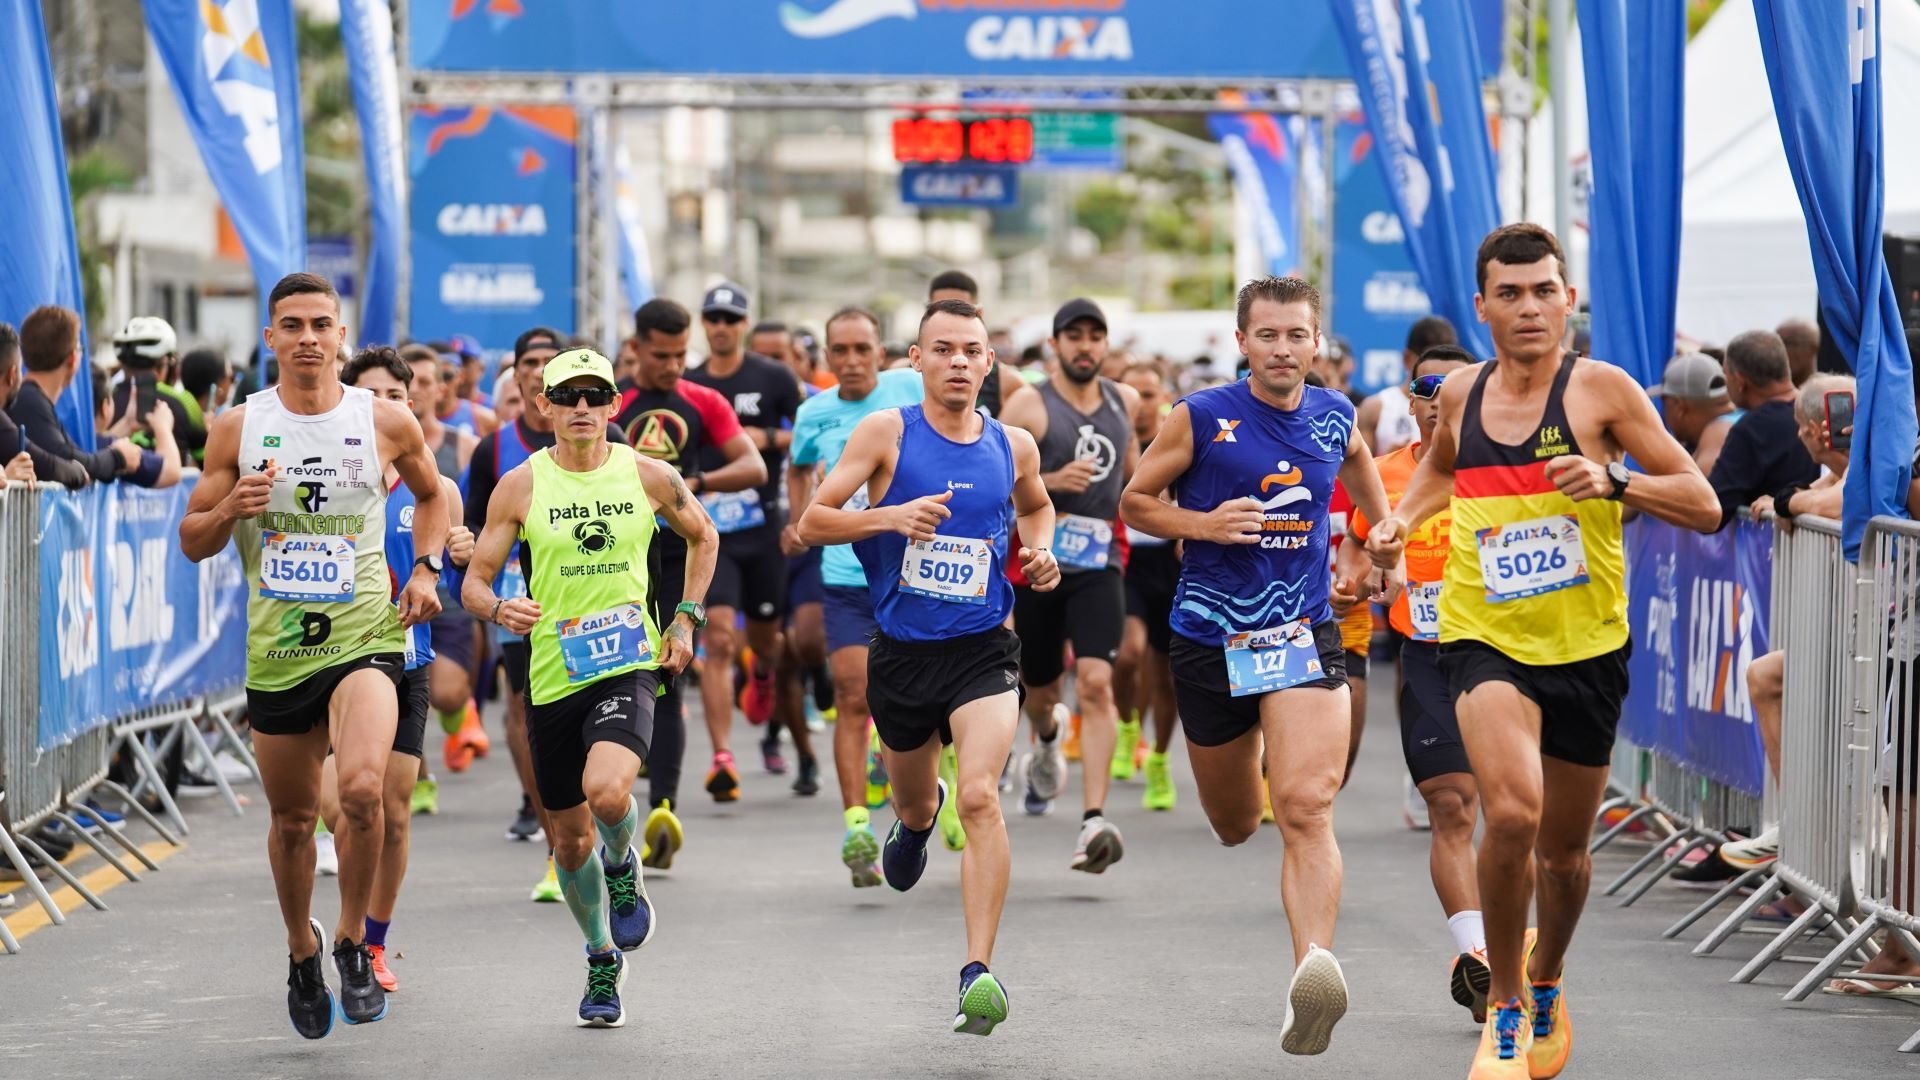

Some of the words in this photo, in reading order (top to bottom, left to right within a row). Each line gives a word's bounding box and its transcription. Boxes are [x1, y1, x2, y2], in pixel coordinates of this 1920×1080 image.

[966, 16, 1133, 60] CAIXA
[912, 174, 1004, 199] CAIXA
[437, 203, 547, 236] CAIXA
[286, 467, 337, 476] revom
[549, 502, 590, 524] pata
[596, 501, 634, 517] leve
[1264, 513, 1289, 521] CUITO
[1289, 513, 1300, 521] DE
[1261, 520, 1314, 531] ORRIDAS
[1260, 535, 1308, 549] CAIXA
[1504, 526, 1552, 544] CAIXA
[285, 541, 328, 551] CAIXA
[932, 541, 972, 554] CAIXA
[560, 566, 585, 577] EQUIPE
[586, 565, 595, 575] DE
[597, 561, 629, 574] ATLETISMO
[1496, 546, 1567, 579] 5026
[270, 558, 338, 582] 15610
[919, 558, 974, 584] 5019
[341, 581, 352, 593] C
[977, 585, 985, 595] A
[1424, 587, 1442, 597] CAI
[582, 613, 621, 631] CAIXA
[1249, 630, 1288, 645] CAIXA
[266, 646, 341, 659] RUNNING
[586, 631, 621, 660] 117
[640, 643, 649, 654] A
[406, 652, 414, 662] B
[1252, 649, 1287, 675] 127
[1310, 661, 1320, 672] A
